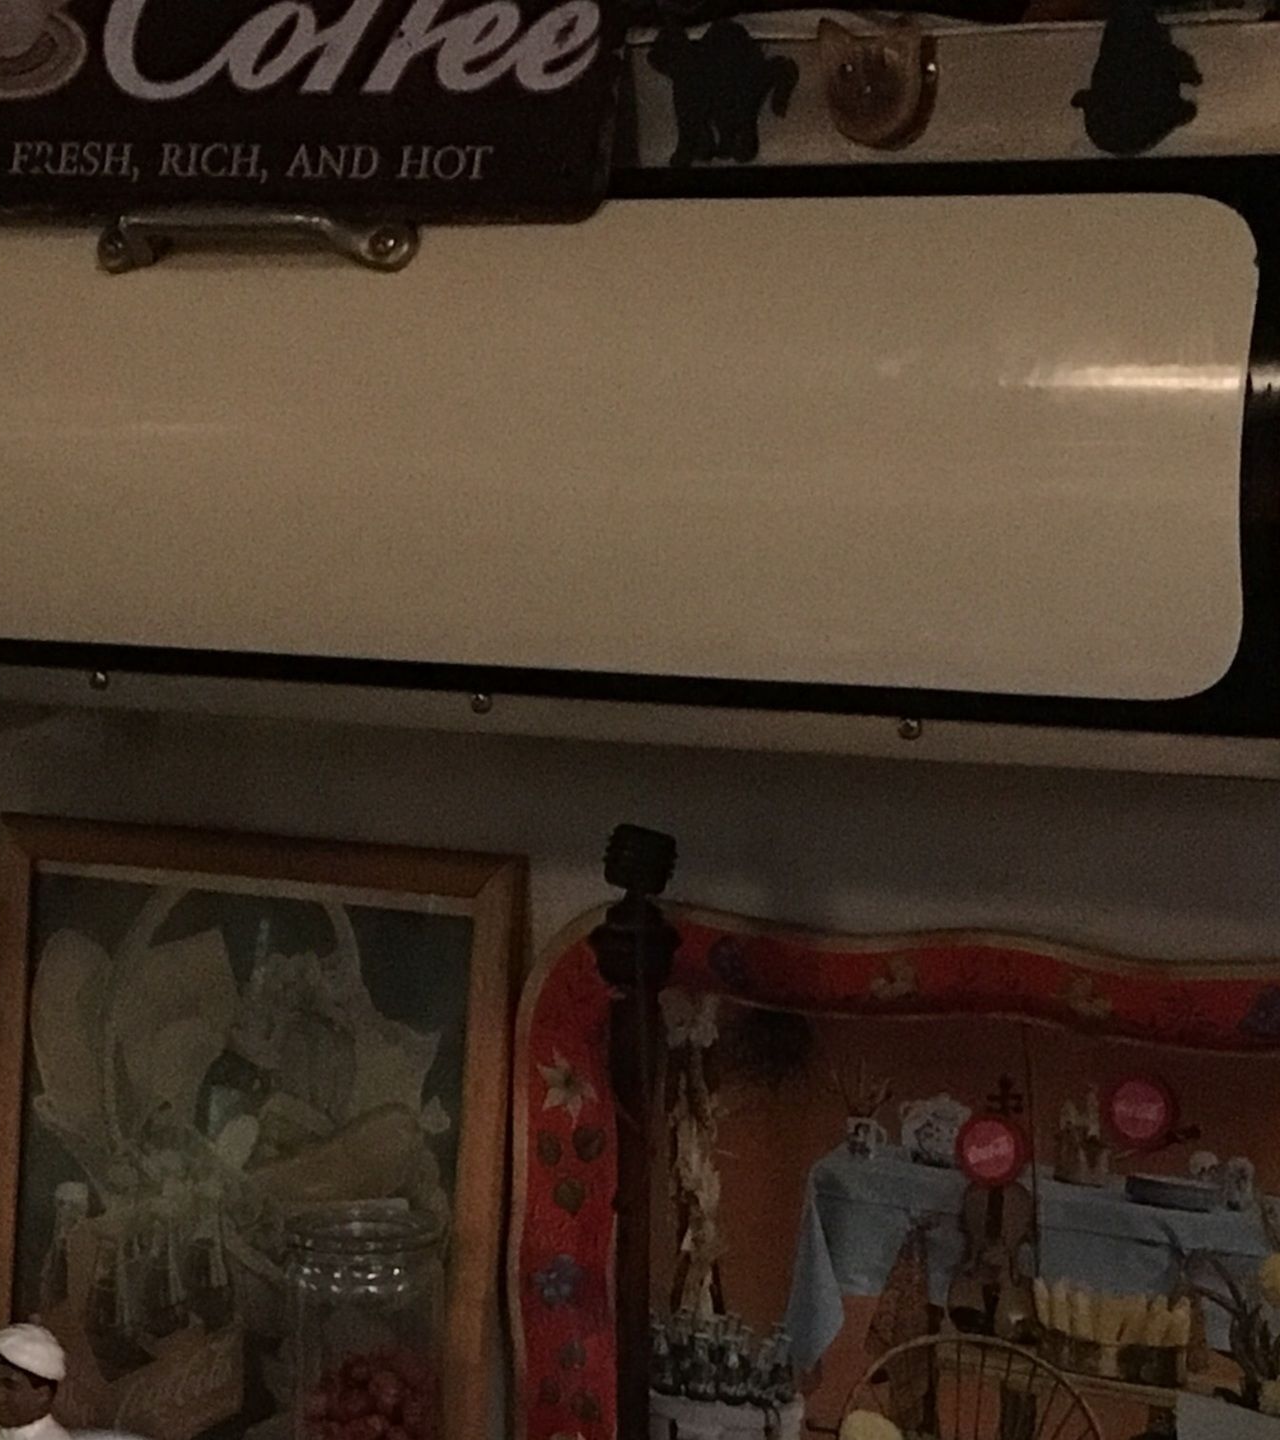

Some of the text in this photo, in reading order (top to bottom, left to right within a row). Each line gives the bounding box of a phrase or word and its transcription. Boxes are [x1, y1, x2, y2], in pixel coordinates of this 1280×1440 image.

[8, 141, 495, 184] FRESH, RICH, AND HOT
